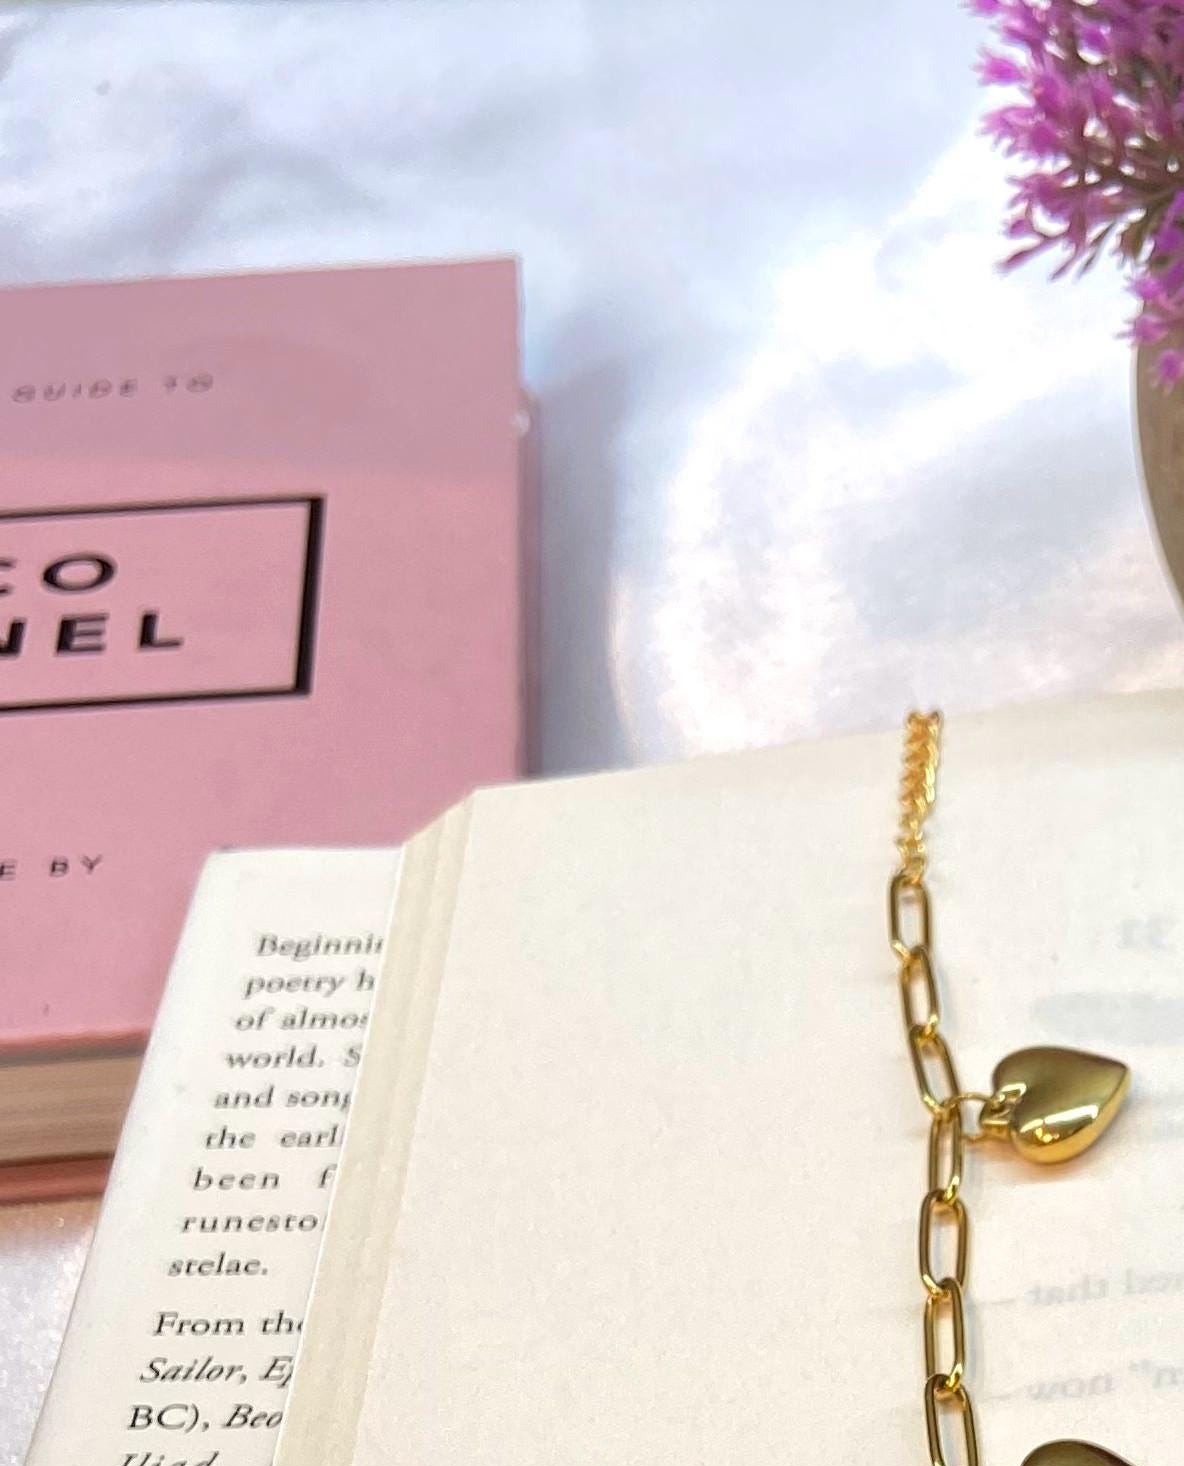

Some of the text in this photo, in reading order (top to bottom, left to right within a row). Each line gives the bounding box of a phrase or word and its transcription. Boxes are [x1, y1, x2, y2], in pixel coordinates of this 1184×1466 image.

[49, 854, 103, 878] BY
[242, 975, 347, 1001] poetry
[234, 1005, 276, 1031] of
[226, 1044, 325, 1069] world.
[214, 1084, 275, 1109] and
[204, 1126, 256, 1150] the
[192, 1167, 281, 1191] been
[181, 1213, 327, 1235] runesto
[166, 1252, 269, 1277] stelae.
[151, 1311, 246, 1337] From
[139, 1355, 248, 1385] Sailor,
[127, 1403, 210, 1433] BC),
